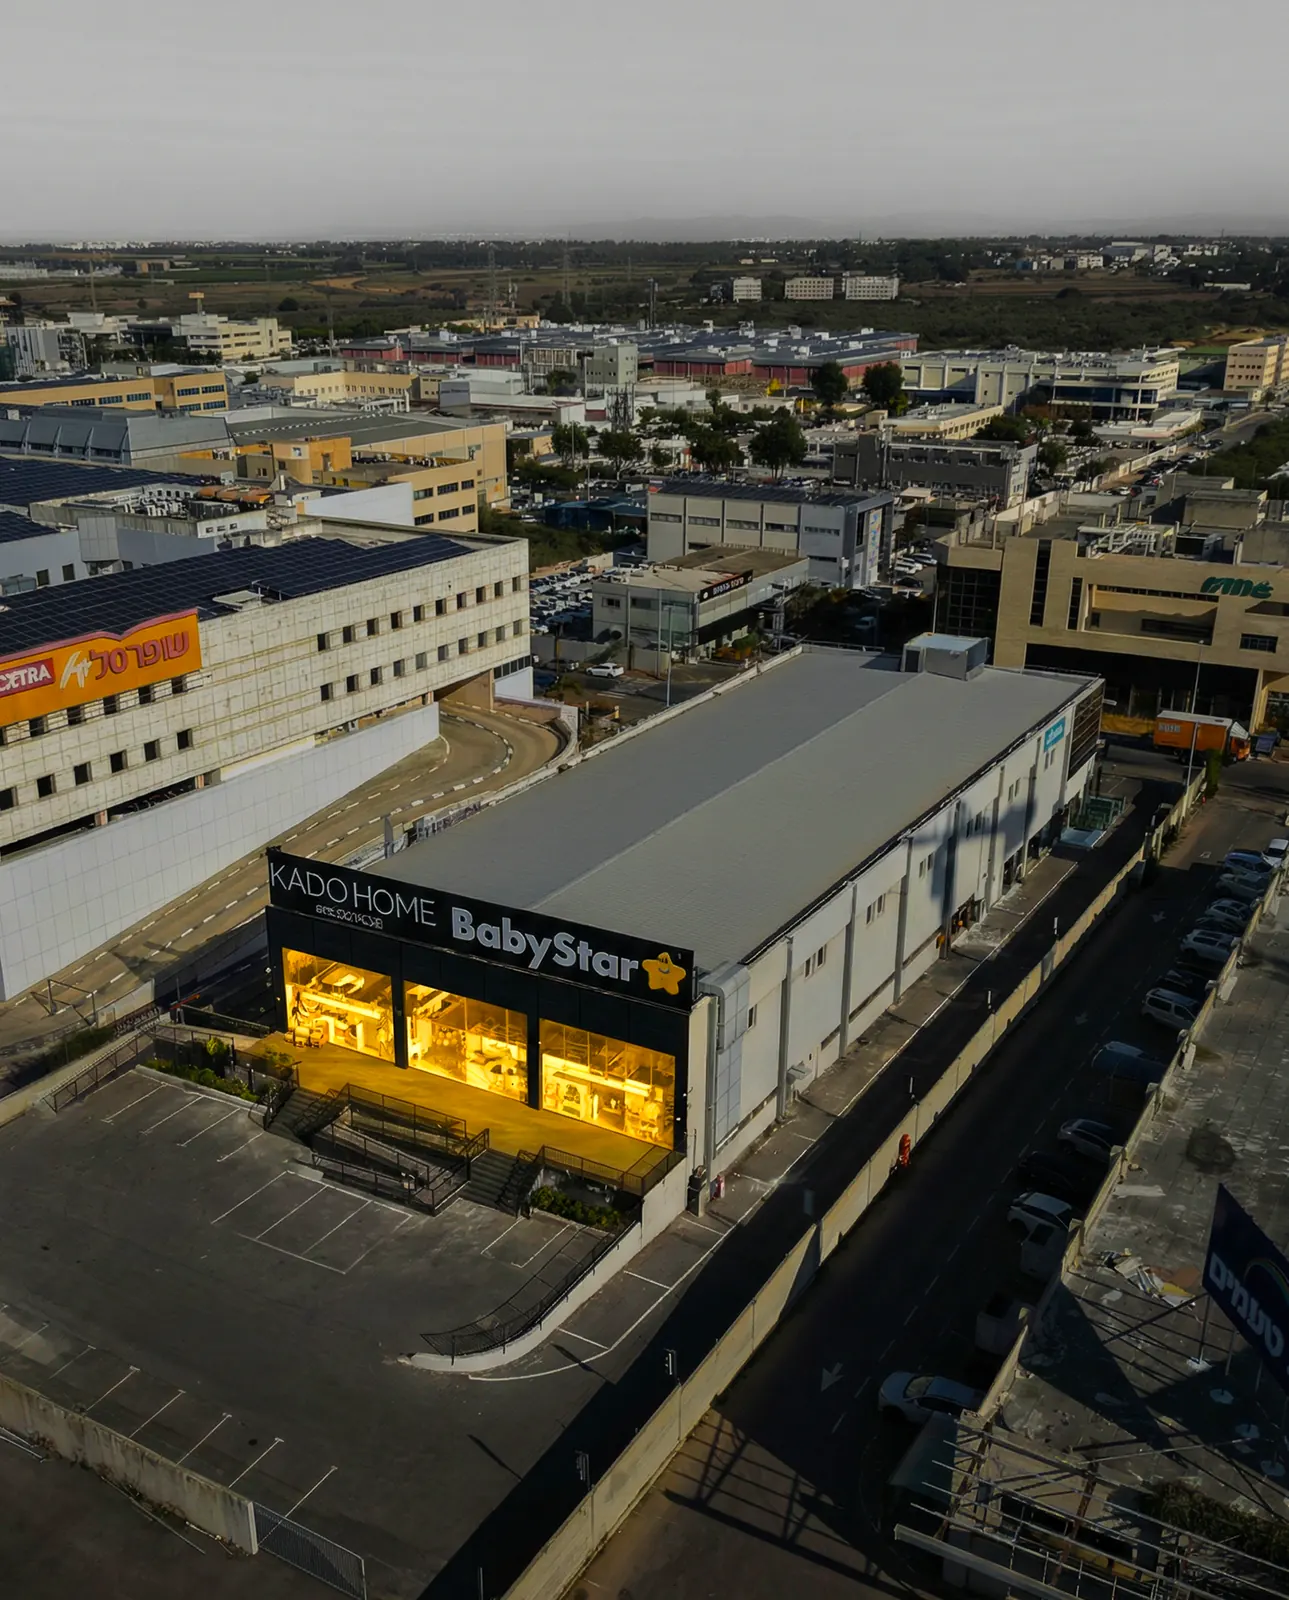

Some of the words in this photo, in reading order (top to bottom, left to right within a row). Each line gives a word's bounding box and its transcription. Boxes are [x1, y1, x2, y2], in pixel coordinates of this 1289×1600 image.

[89, 631, 190, 680] שופרסל
[270, 862, 348, 903] KADO
[353, 882, 437, 926] HOME
[452, 906, 639, 982] BabyStar
